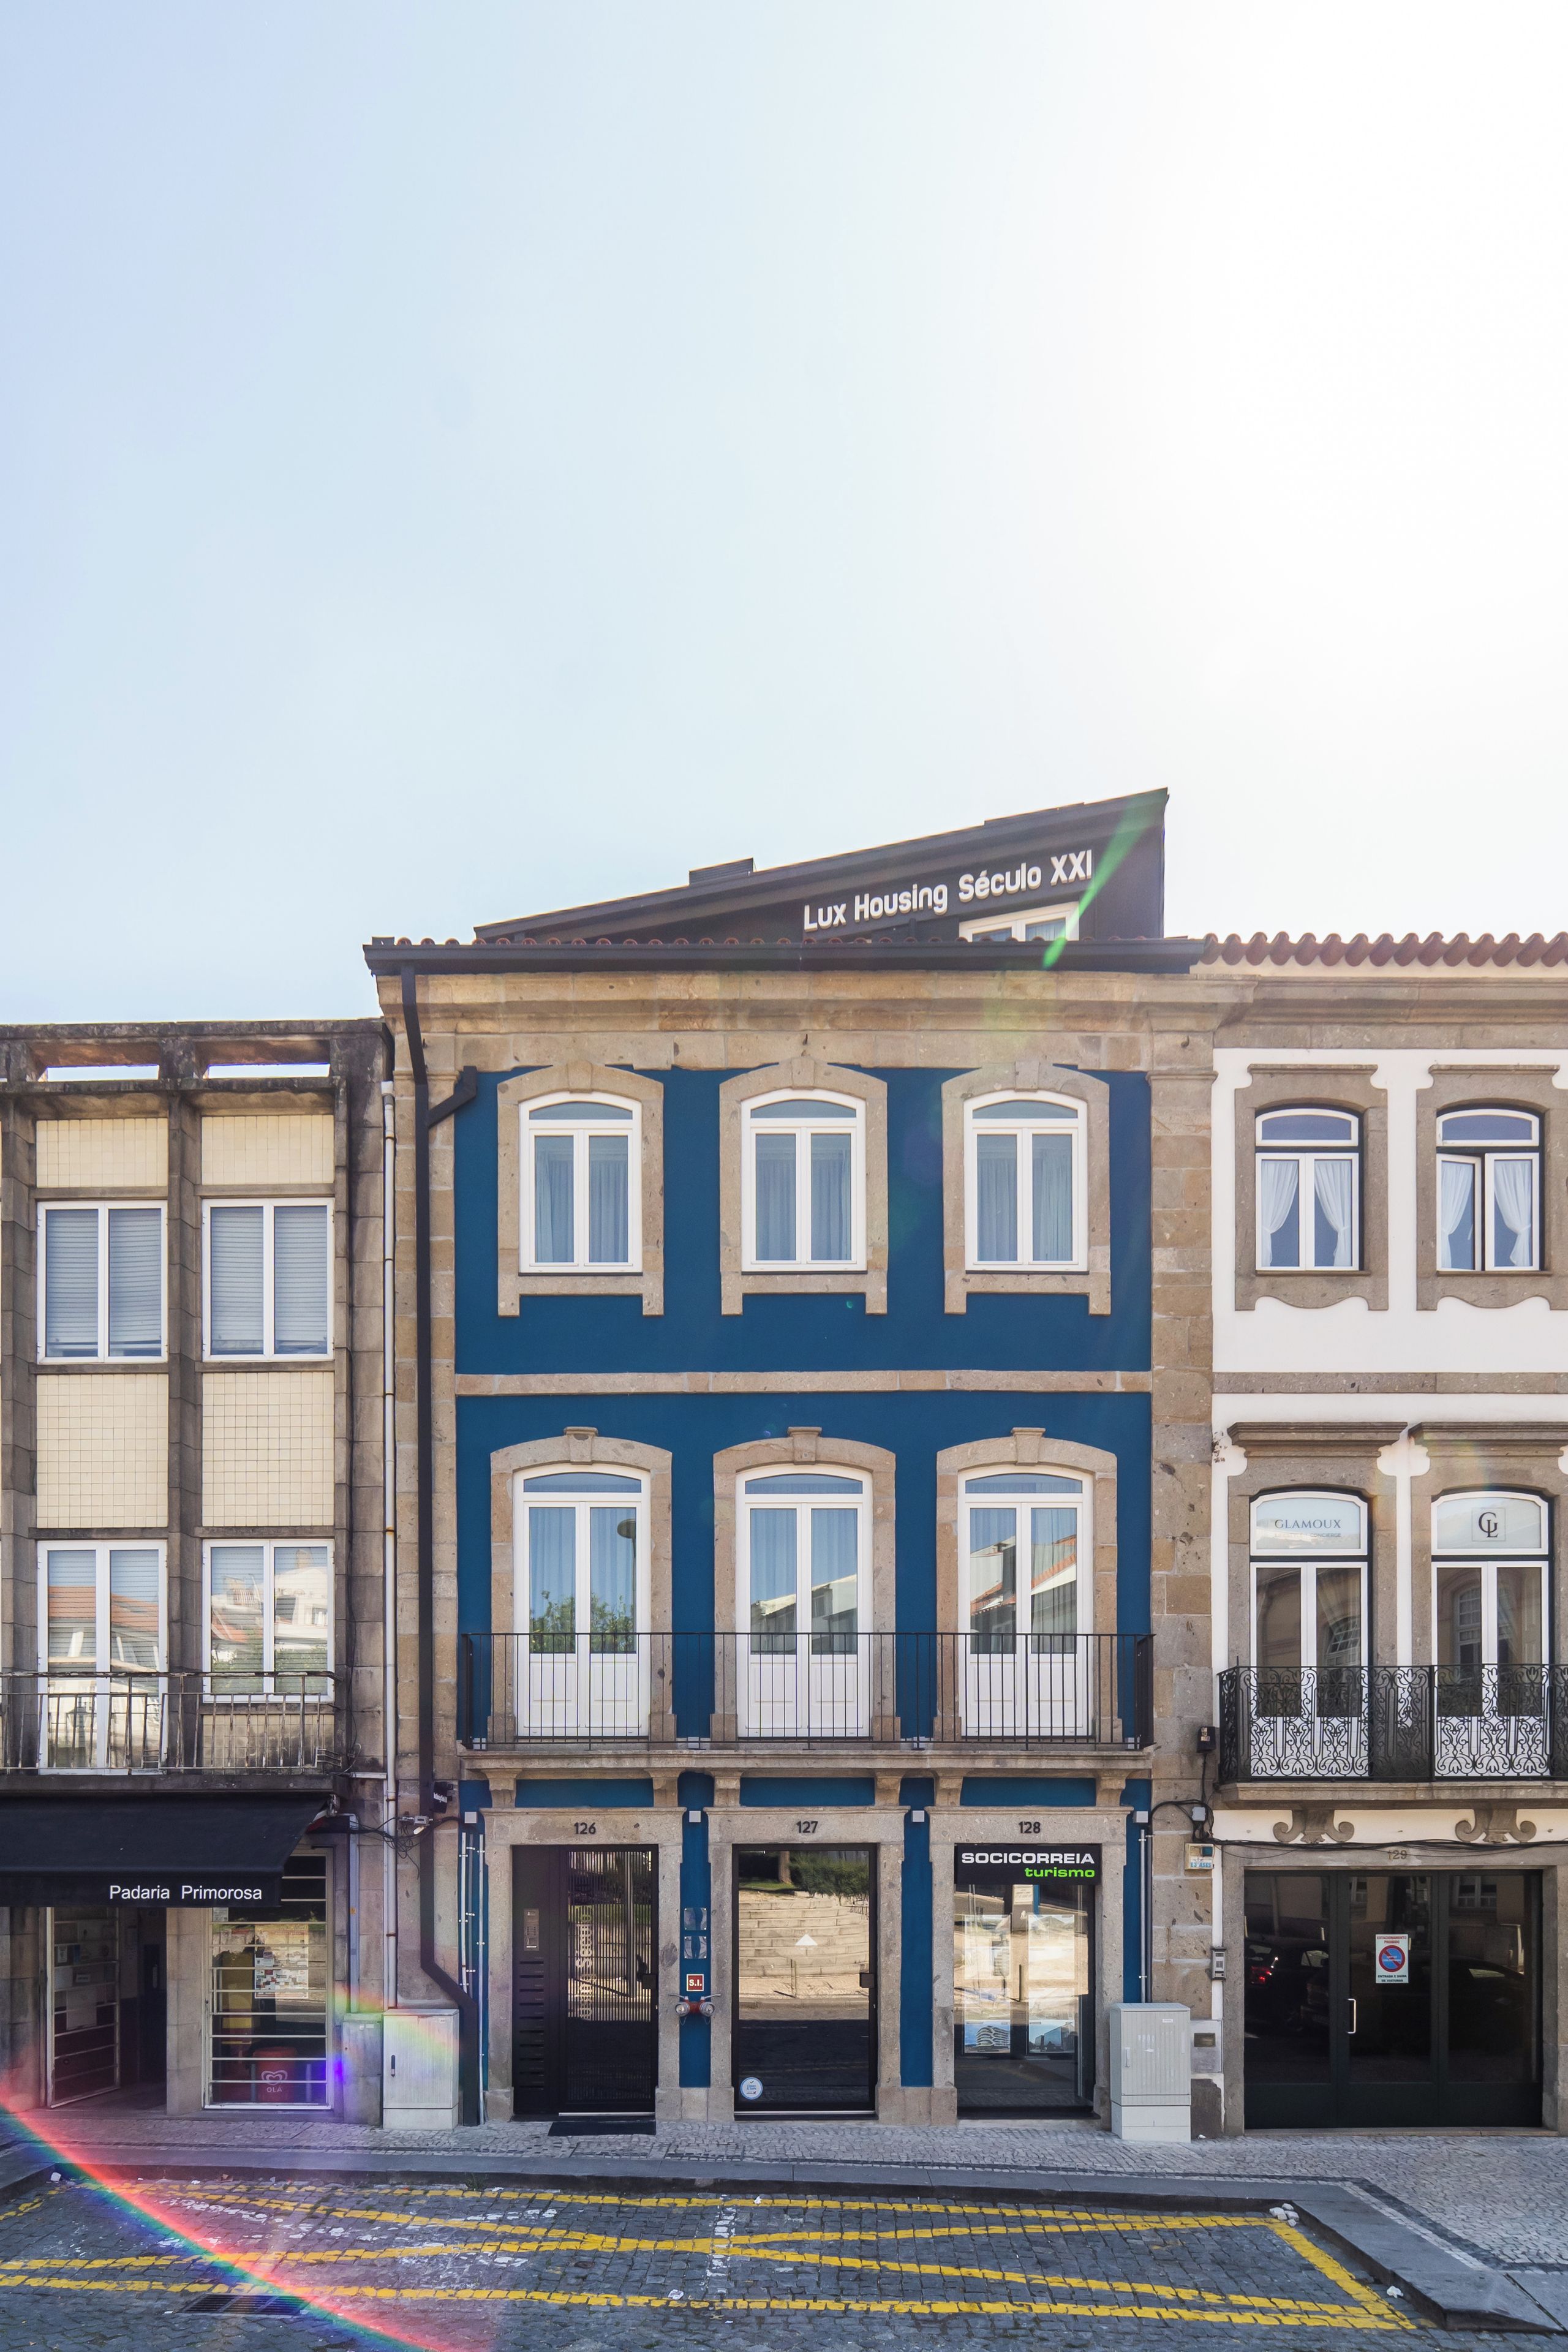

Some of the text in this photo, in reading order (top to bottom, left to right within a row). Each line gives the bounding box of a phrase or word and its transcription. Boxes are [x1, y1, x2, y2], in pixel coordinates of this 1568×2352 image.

[804, 849, 1093, 932] Lux Housing Século XXI
[1275, 1518, 1341, 1529] GLAMOUX
[574, 1822, 597, 1834] 126
[796, 1820, 818, 1834] 127
[1018, 1821, 1041, 1834] 128
[962, 1853, 1095, 1863] SOCICORREIA
[1388, 1849, 1408, 1860] 129
[1025, 1866, 1095, 1877] turismo
[110, 1885, 263, 1900] Padaria Primorosa
[688, 1978, 703, 1987] S.I.
